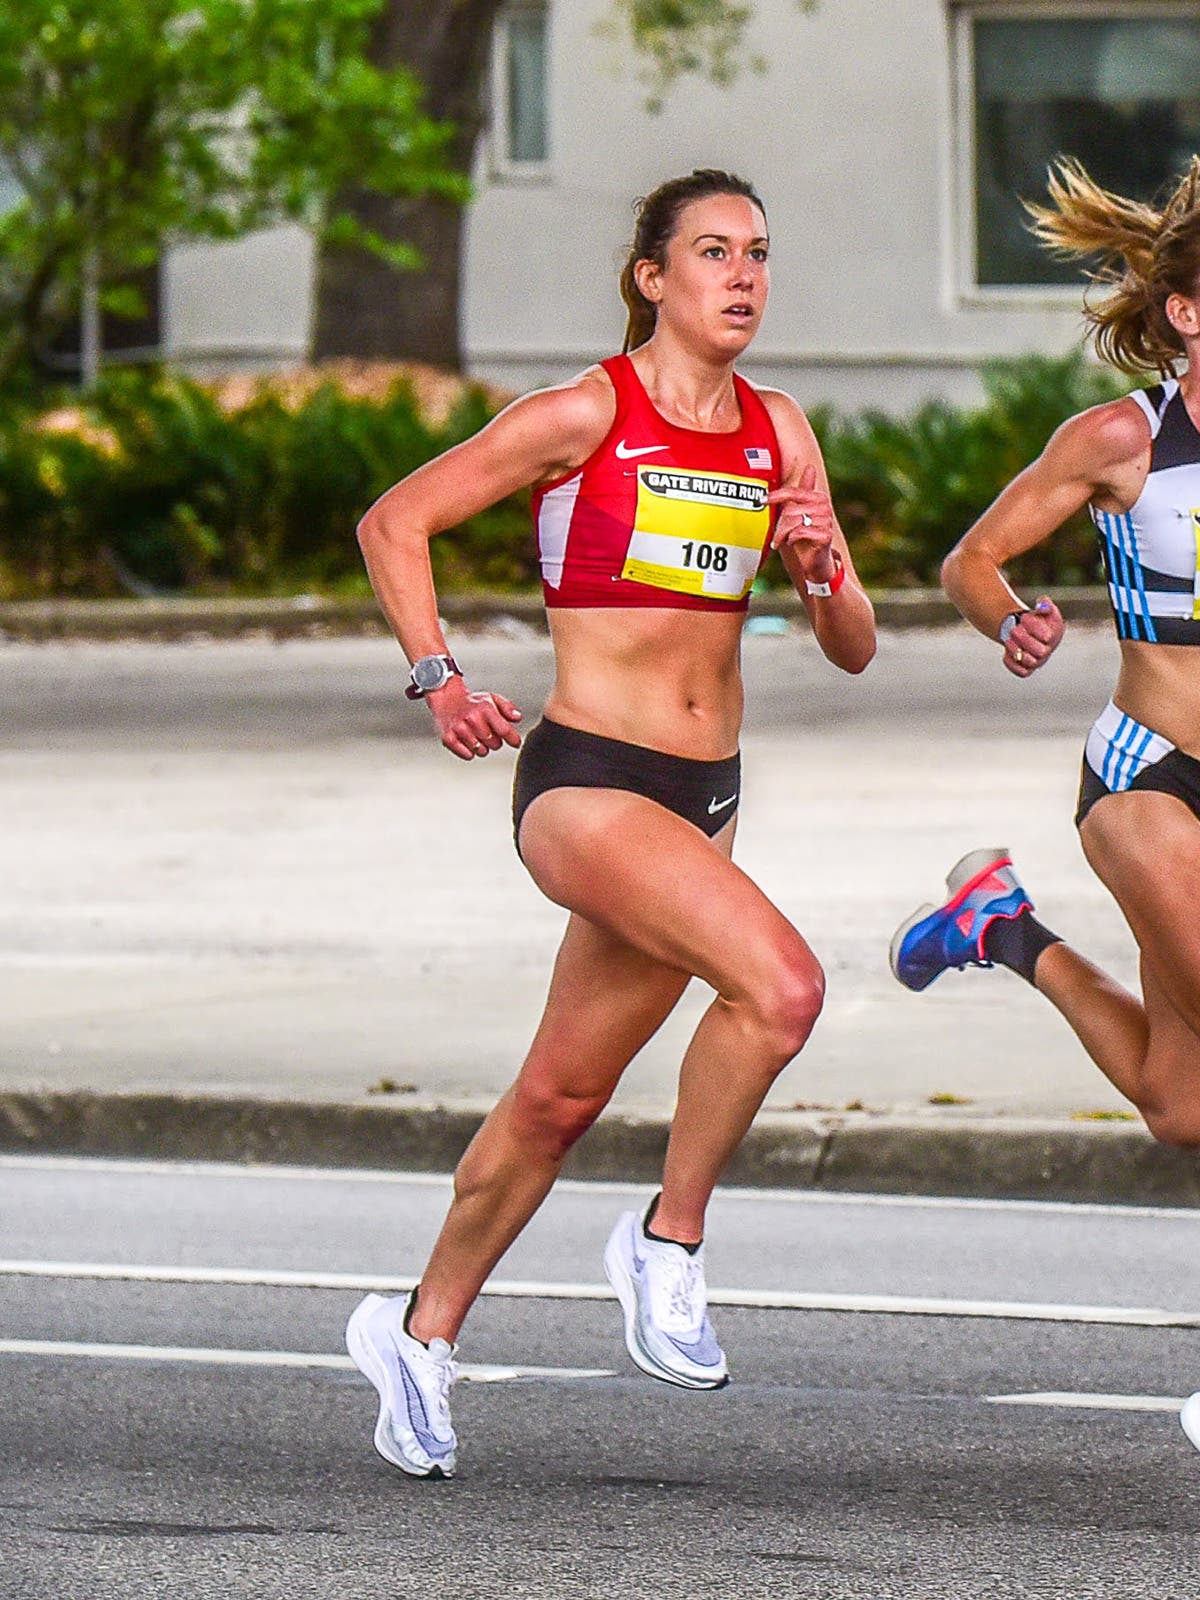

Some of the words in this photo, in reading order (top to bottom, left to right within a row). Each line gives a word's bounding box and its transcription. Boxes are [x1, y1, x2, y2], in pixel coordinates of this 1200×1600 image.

[647, 473, 690, 490] GATE
[691, 478, 738, 497] RIVER
[738, 485, 765, 502] RUN
[682, 541, 729, 572] 108
